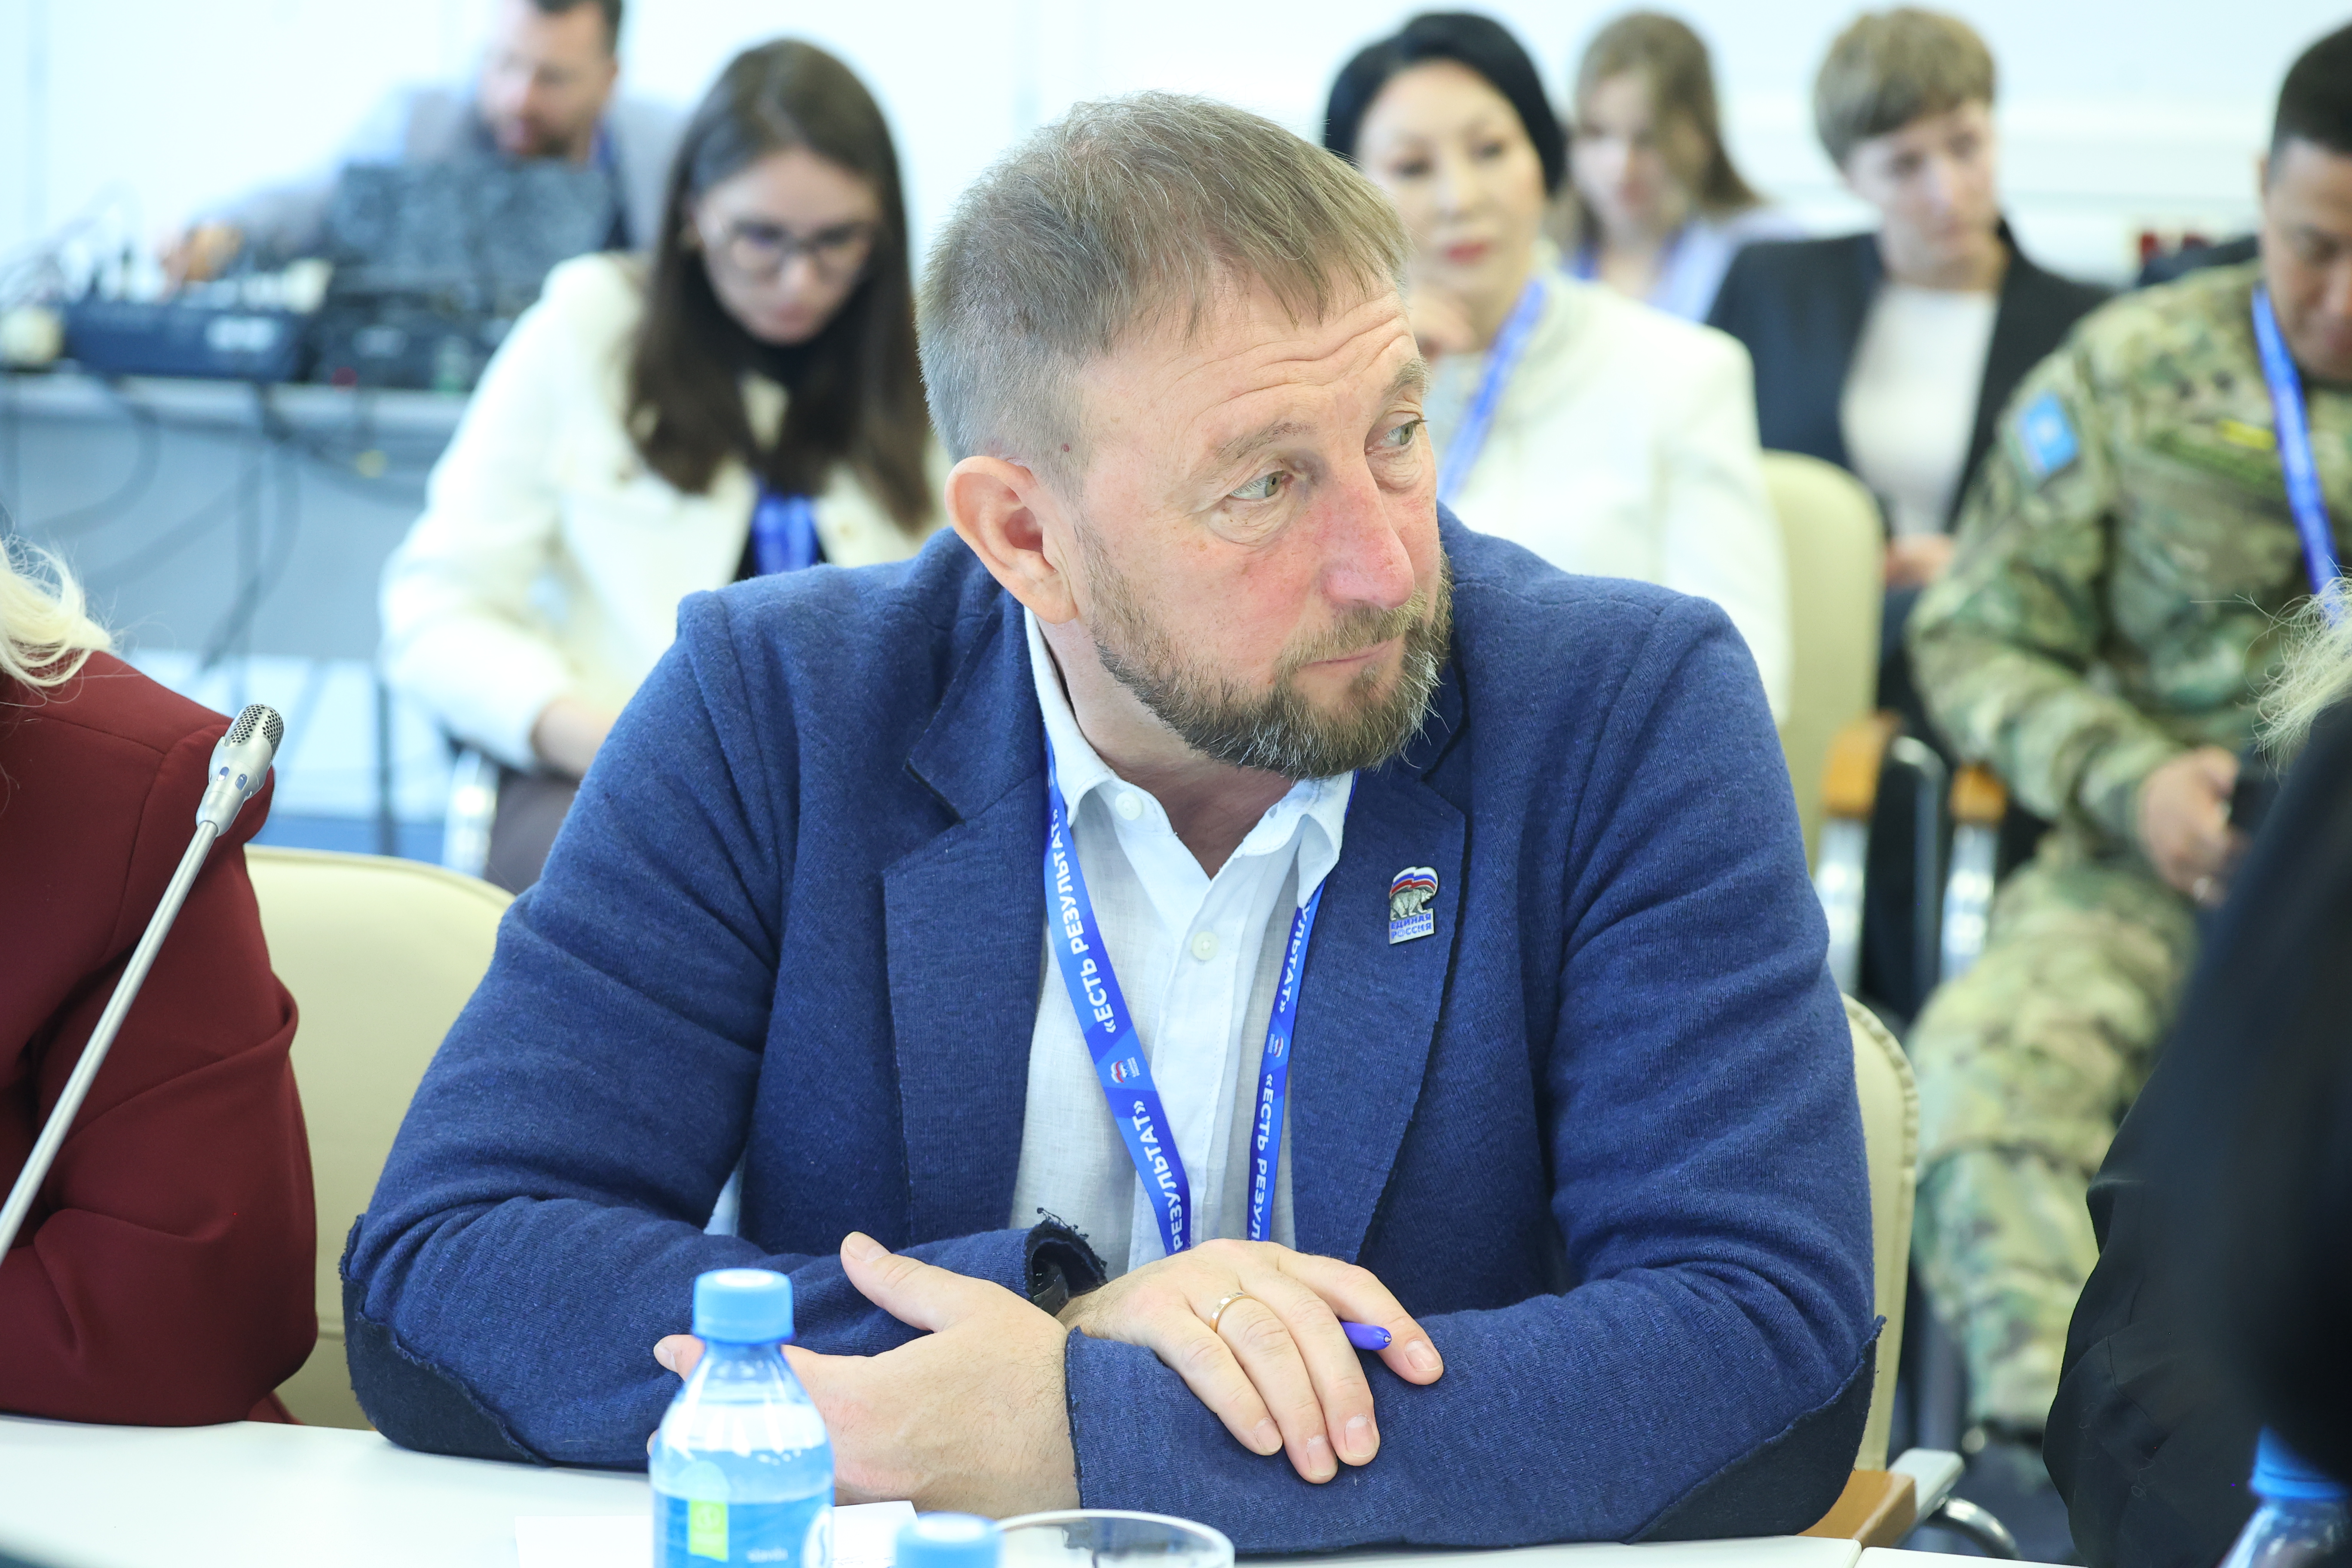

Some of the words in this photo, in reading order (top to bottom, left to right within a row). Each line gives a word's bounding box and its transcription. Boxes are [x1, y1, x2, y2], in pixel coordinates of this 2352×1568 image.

[1050, 808, 1090, 955] РЕЗУЛЬТАТ»
[1391, 913, 1431, 929] ЕДИНАЯ
[1279, 905, 1311, 1014] УЛЬТАТ»
[1391, 922, 1432, 939] РОССИЯ
[1080, 958, 1117, 1033] «ЕСТЬ
[1257, 1073, 1274, 1151] «ЕСТЬ
[1132, 1100, 1184, 1251] РЕЗУЛЬТАТ»
[1251, 1158, 1268, 1240] РЕЗУЛ
